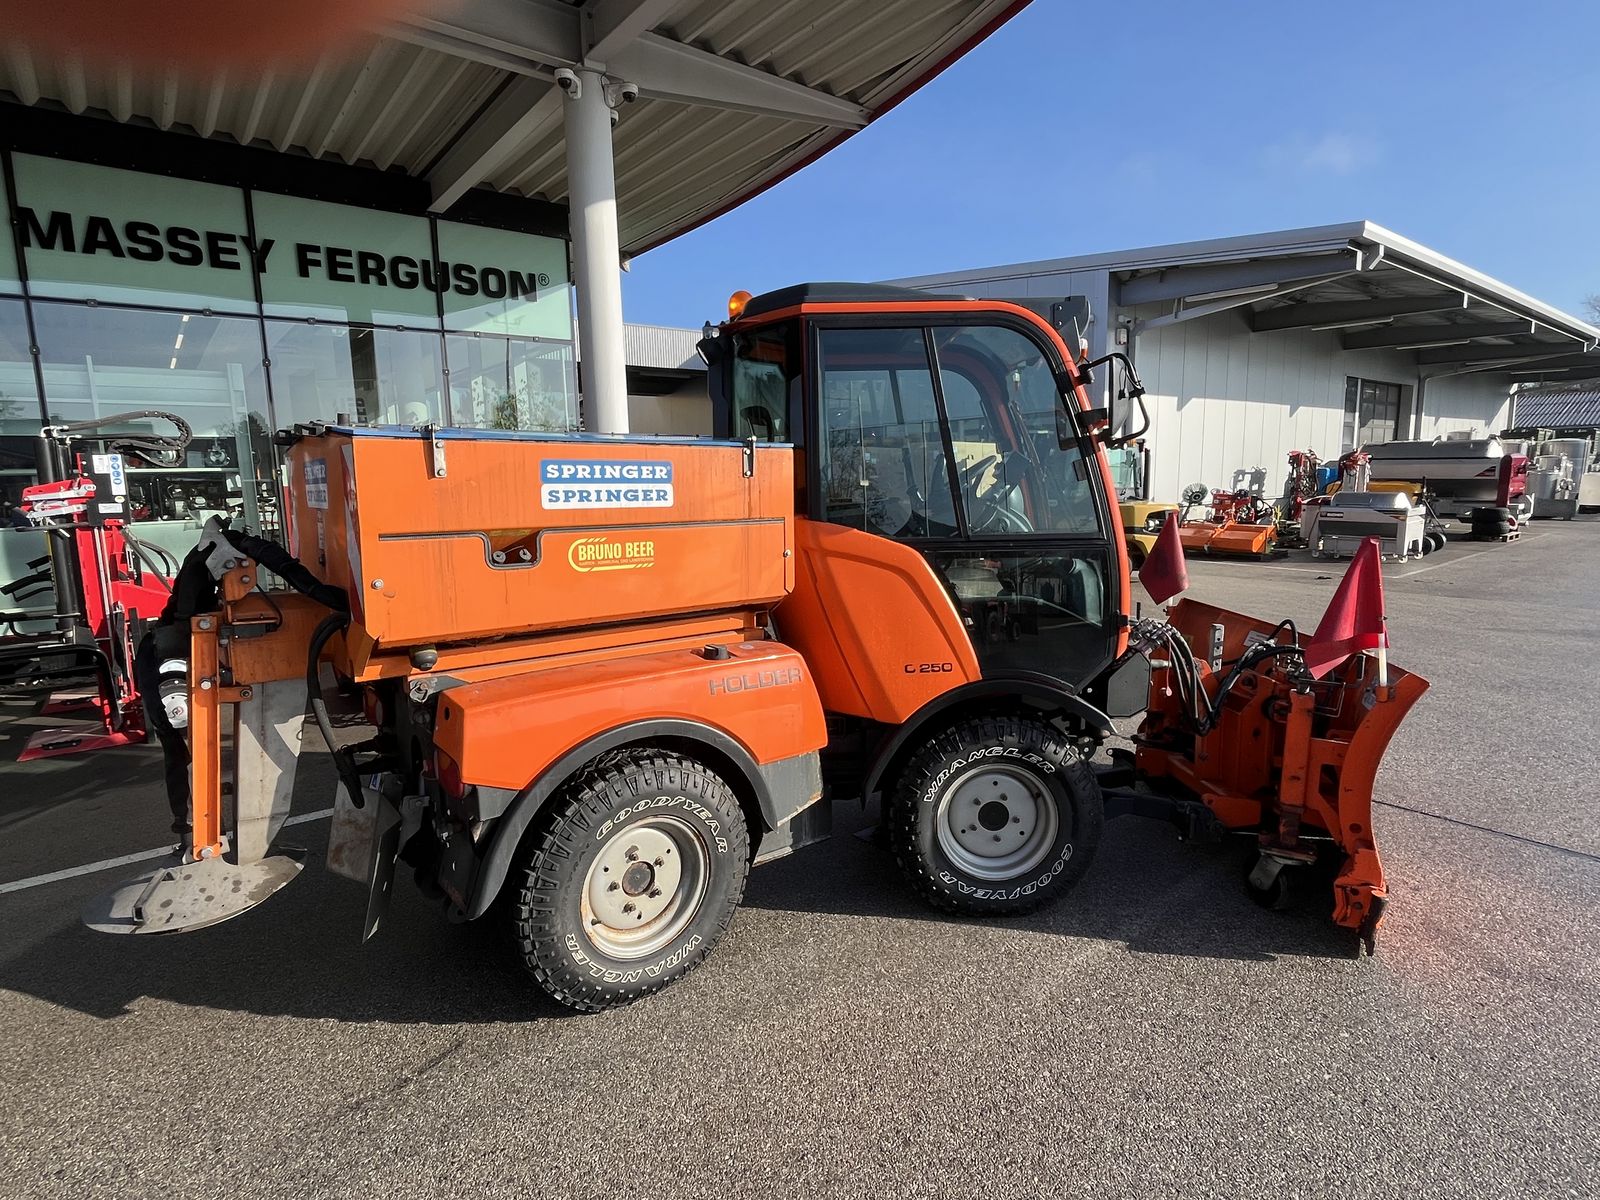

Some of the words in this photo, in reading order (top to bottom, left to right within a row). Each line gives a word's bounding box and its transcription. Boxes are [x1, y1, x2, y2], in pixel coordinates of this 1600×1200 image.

[16, 205, 275, 274] MASSEY
[546, 464, 668, 479] SPRINGER
[548, 489, 668, 503] SPRINGER
[578, 543, 622, 561] BRUNO
[625, 541, 654, 558] BEER
[709, 667, 802, 695] HOLDER
[919, 662, 953, 674] 250
[923, 746, 1056, 802] WRANGLER
[596, 796, 728, 853] GOODYEAR
[939, 843, 1074, 900] GOODYEAR
[564, 933, 702, 983] WRANGLER
